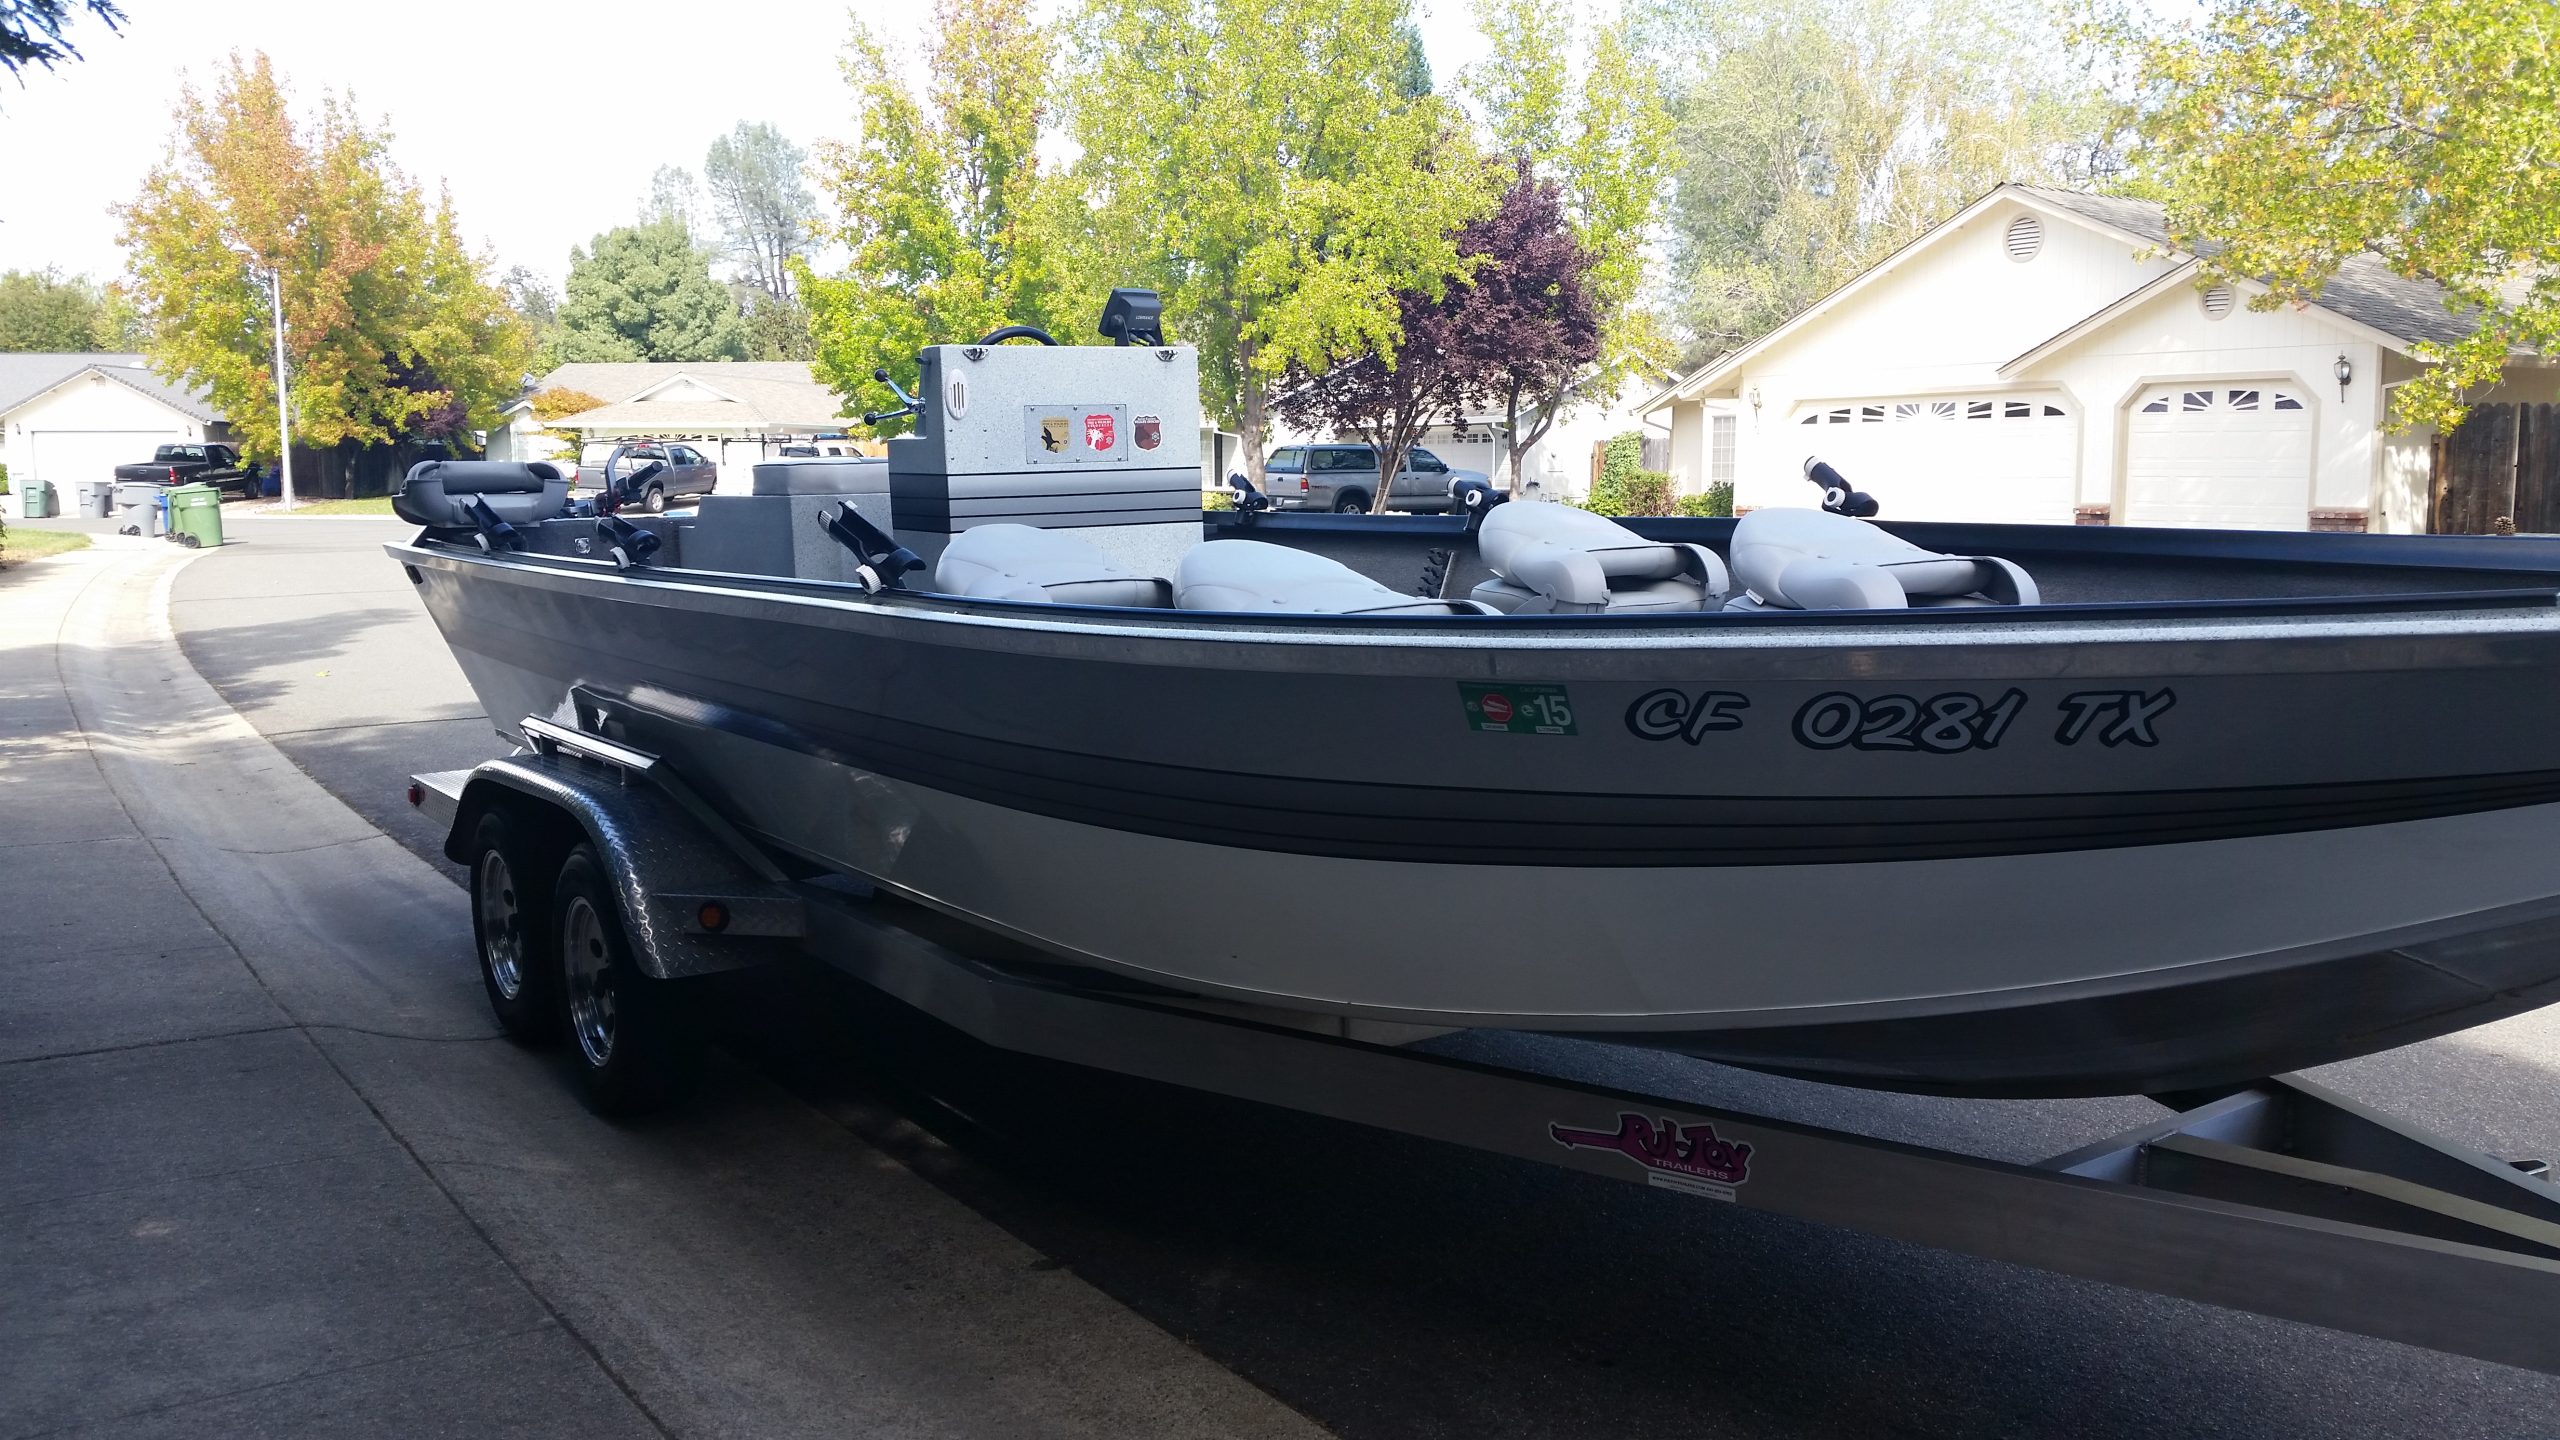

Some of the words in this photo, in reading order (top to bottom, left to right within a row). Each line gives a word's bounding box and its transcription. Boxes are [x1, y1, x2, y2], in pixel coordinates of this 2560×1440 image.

[1533, 694, 1572, 726] 15
[1625, 687, 1750, 745] CF
[1791, 687, 2028, 754] 0281
[2055, 686, 2176, 748] TX
[1653, 1158, 1729, 1180] TRAILERS
